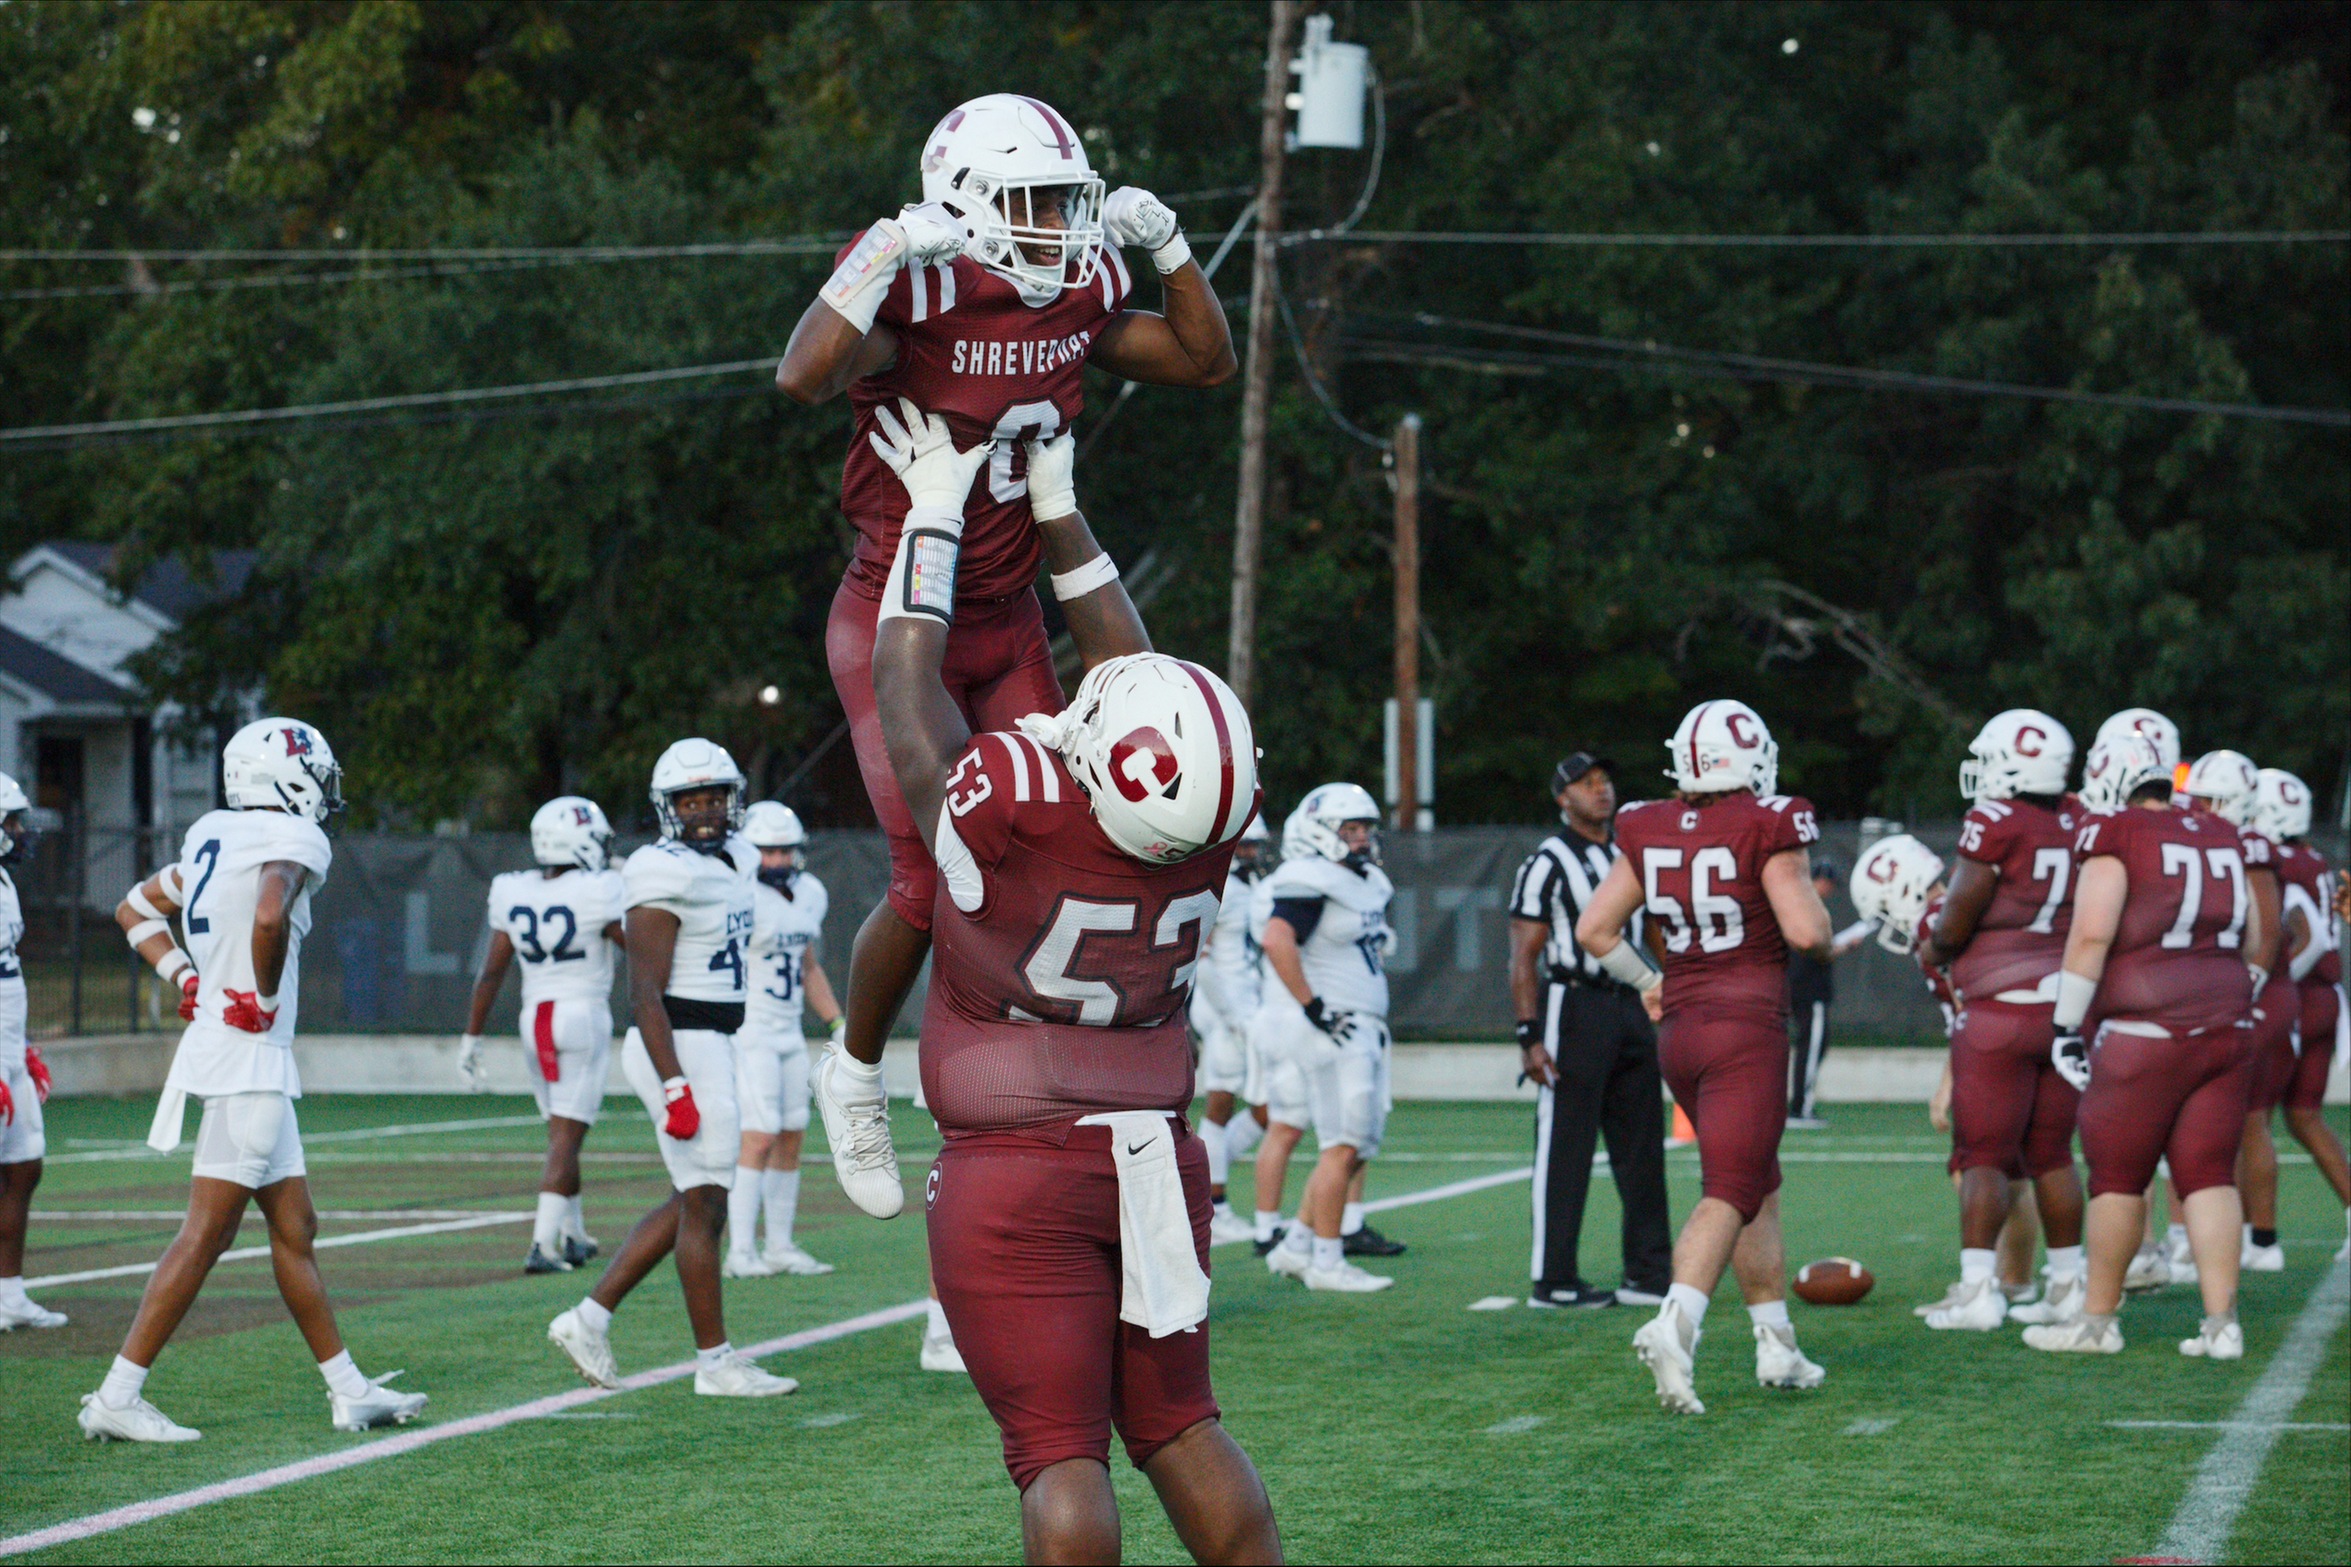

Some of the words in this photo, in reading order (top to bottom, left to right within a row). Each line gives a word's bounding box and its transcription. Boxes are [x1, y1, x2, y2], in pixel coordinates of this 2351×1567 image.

[1726, 713, 1759, 749] C
[2014, 725, 2046, 757] C
[946, 747, 992, 817] 53
[1109, 726, 1178, 803] C
[1681, 811, 1698, 830] C
[1793, 811, 1820, 843] 56
[1959, 821, 1985, 852] 75
[187, 839, 220, 935] 2
[1643, 846, 1744, 953] 56
[2027, 848, 2078, 933] 7
[2161, 843, 2248, 948] 77
[508, 906, 585, 963] 32
[927, 1170, 939, 1202] C
